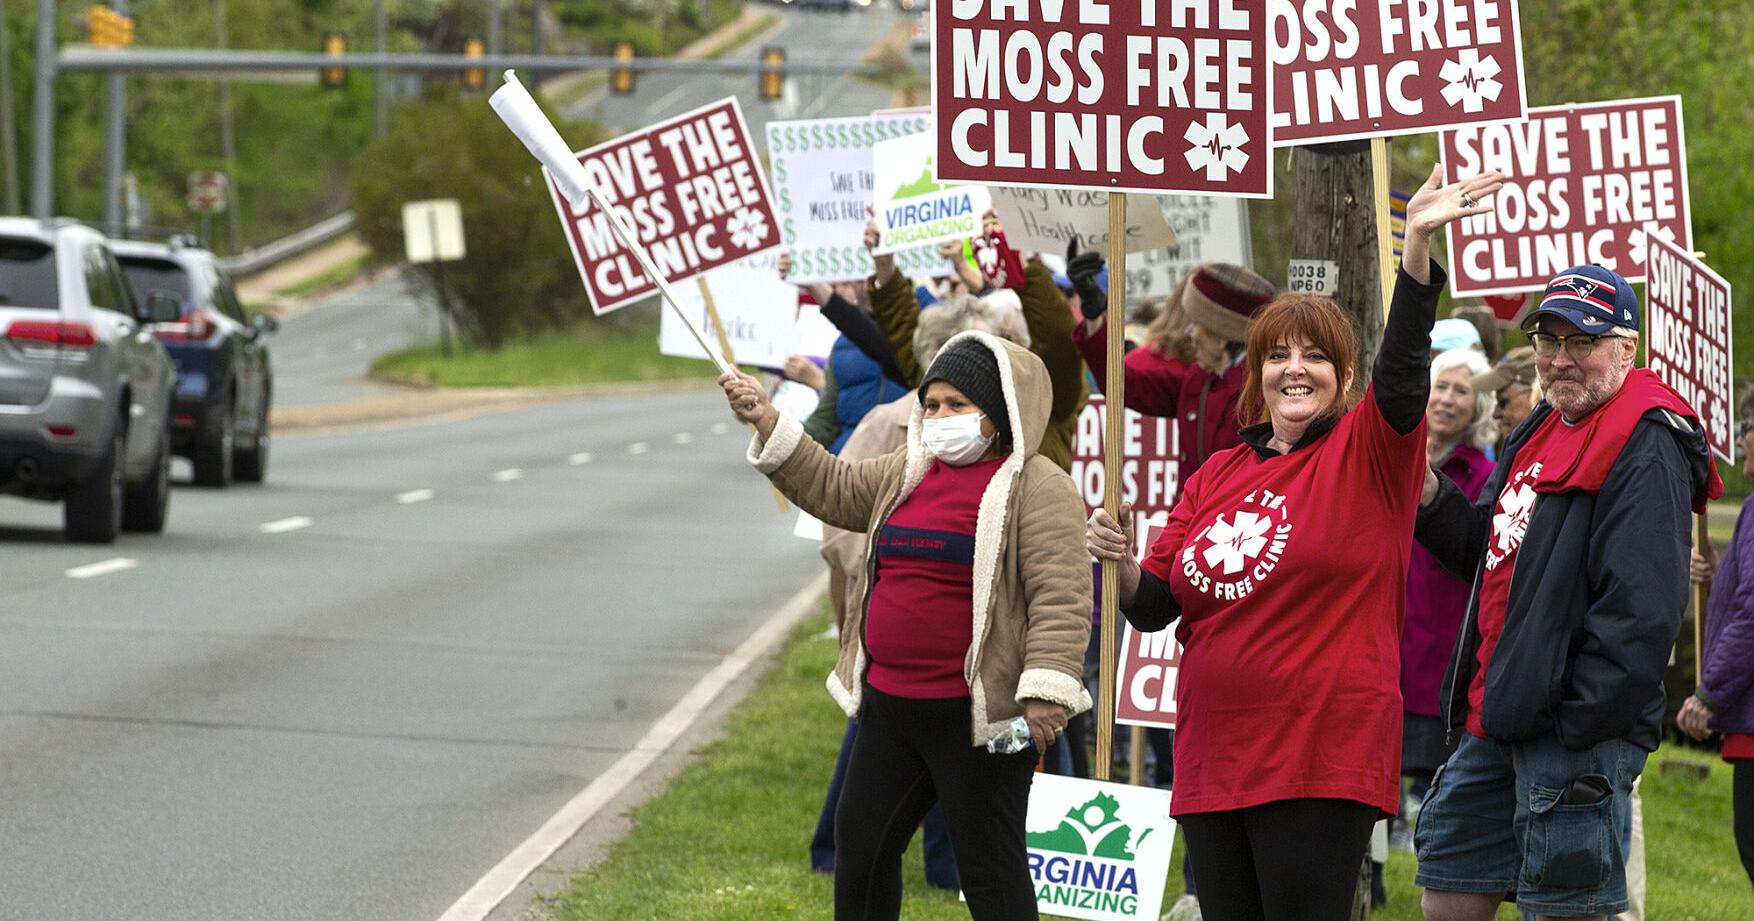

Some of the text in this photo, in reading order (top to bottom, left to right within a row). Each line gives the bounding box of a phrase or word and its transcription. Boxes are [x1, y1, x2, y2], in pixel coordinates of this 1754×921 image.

[1273, 0, 1360, 65] OSS
[1378, 0, 1502, 54] FREE
[953, 28, 1252, 111] MOSS FREE
[567, 110, 743, 216] AVE THE
[951, 108, 1164, 175] CLINIC
[1454, 107, 1671, 182] SAVE THE
[675, 160, 761, 226] FREE
[885, 194, 973, 230] VIRGINIA
[1582, 169, 1677, 226] FREE
[595, 223, 725, 297] CLNIC
[884, 216, 974, 247] ORGANIZING
[1462, 228, 1618, 282] CLINIC
[1651, 242, 1726, 347] SAVE THE
[1651, 301, 1727, 402] MOSS FREE
[1181, 523, 1293, 601] MOSS FREE CLINIC
[1026, 852, 1139, 895] RGINIA
[1036, 883, 1139, 916] ANIZING
